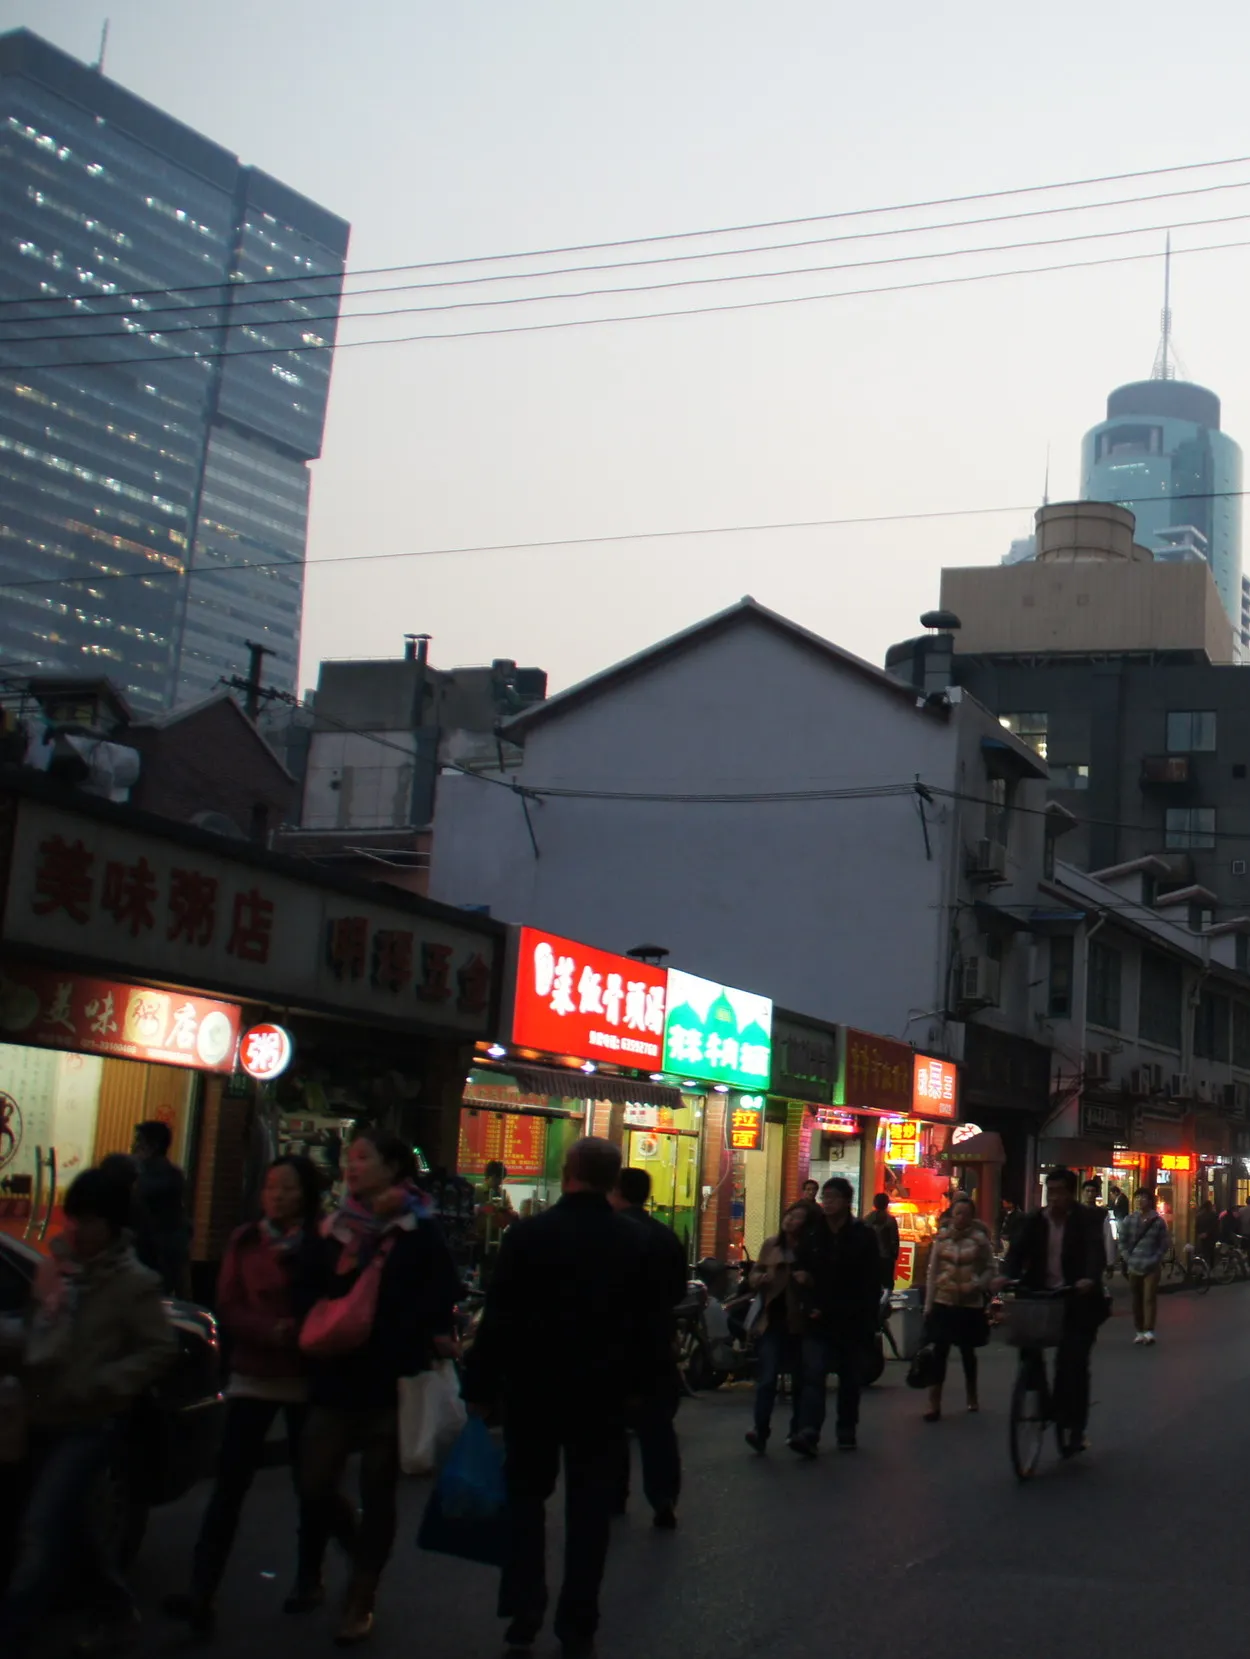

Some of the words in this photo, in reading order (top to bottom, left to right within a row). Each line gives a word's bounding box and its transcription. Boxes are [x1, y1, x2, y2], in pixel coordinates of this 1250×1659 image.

[33, 834, 274, 964] 美味粥店
[43, 981, 198, 1049] 美味粥店
[247, 1032, 281, 1071] 粥
[732, 1109, 758, 1148] 拉面
